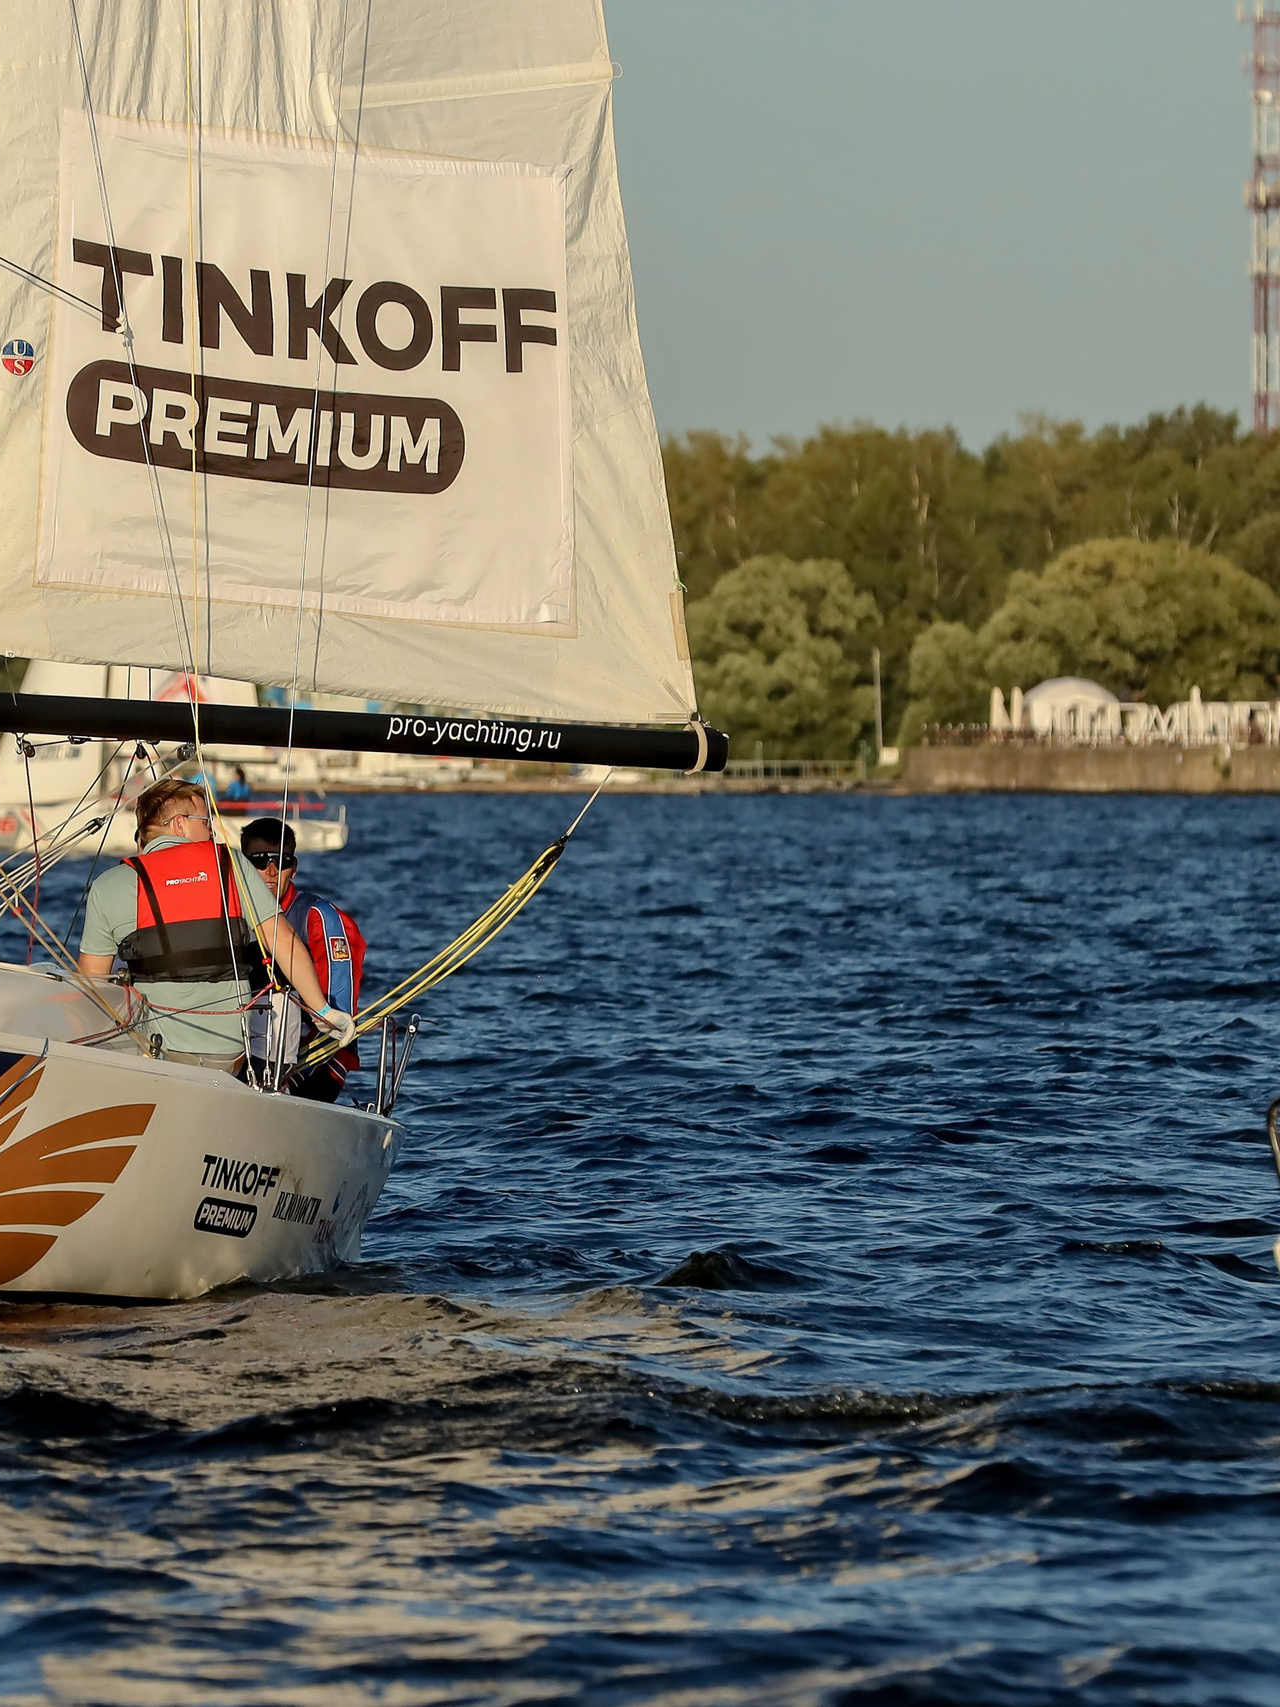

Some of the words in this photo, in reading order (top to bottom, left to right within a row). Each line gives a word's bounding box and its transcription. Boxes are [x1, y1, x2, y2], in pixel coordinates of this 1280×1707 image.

[73, 238, 558, 373] TINKOFF
[95, 378, 441, 474] PREMIUM
[387, 716, 562, 752] pro-yachting.ru
[165, 875, 208, 886] PROYACHTING
[200, 1154, 281, 1198] TINKOFF
[197, 1202, 255, 1233] PREMIUM
